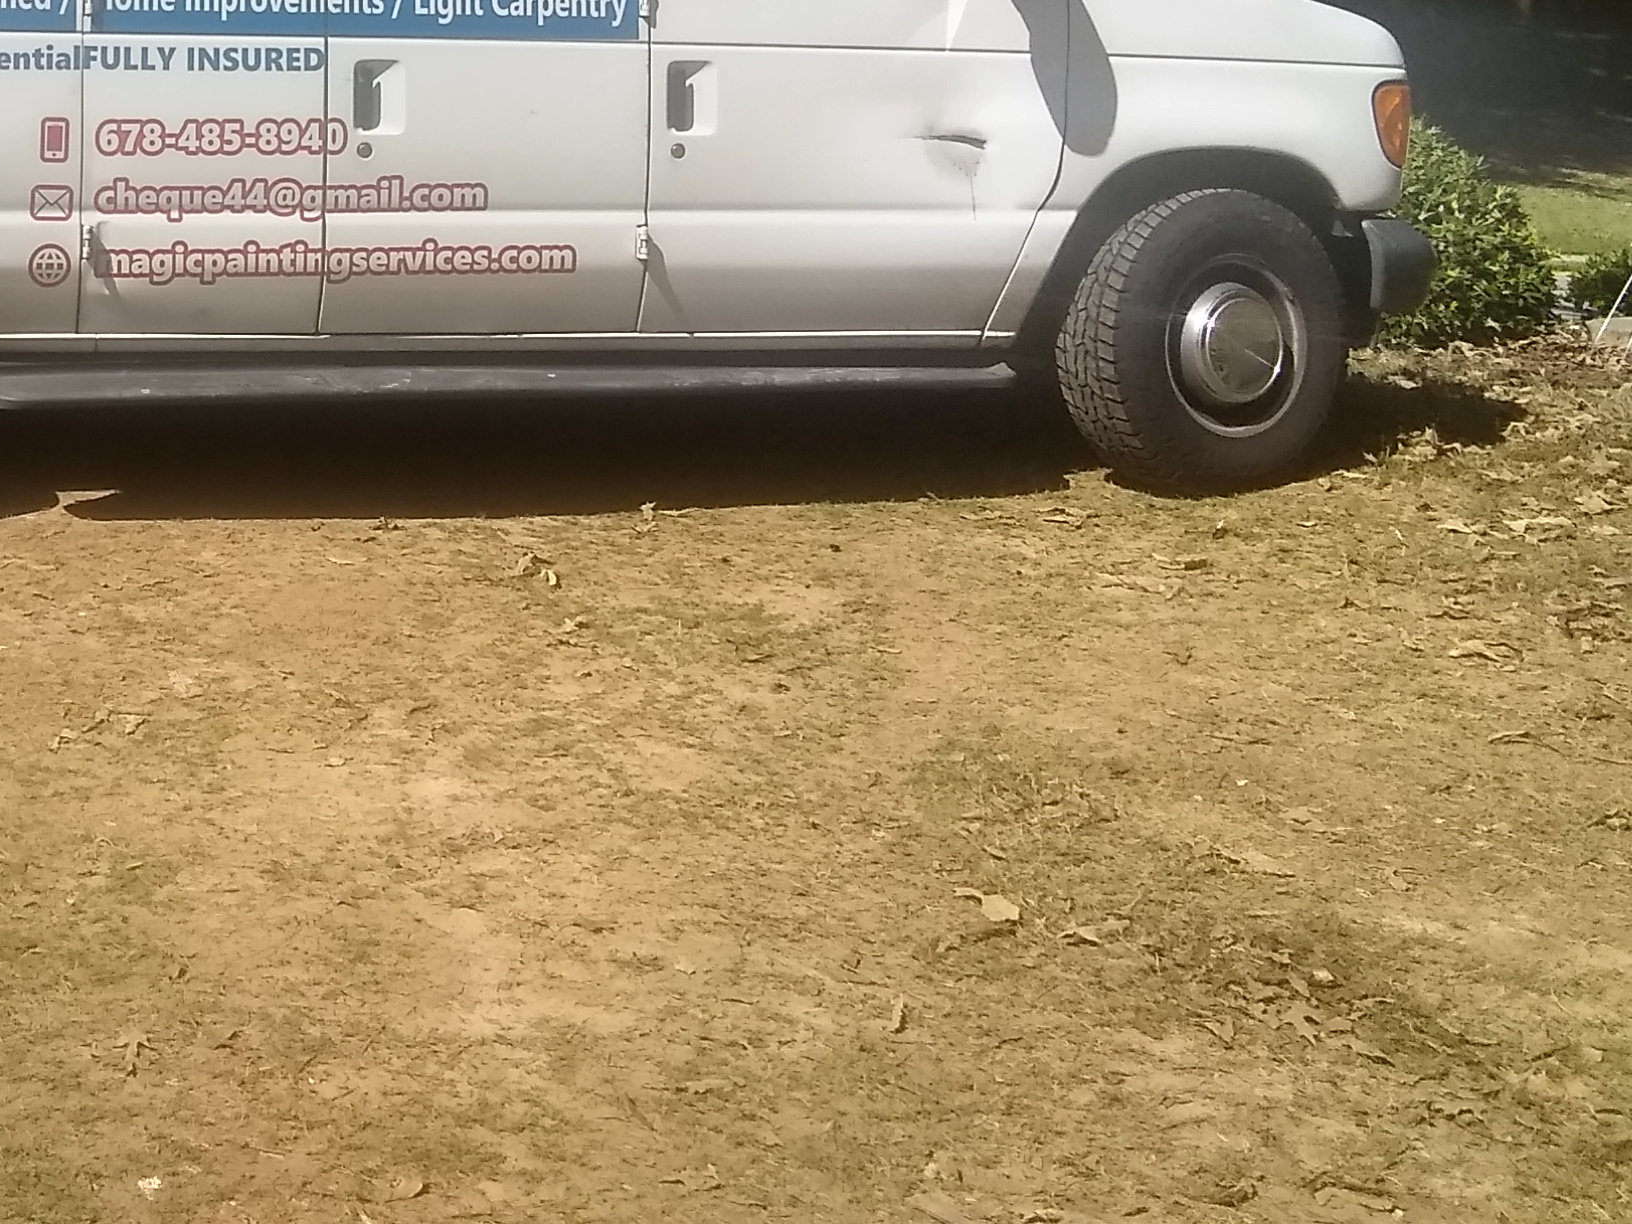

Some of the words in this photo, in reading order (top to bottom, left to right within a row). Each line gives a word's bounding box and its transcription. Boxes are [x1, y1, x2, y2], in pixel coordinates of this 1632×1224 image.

[83, 46, 177, 71] FULLY
[186, 47, 325, 73] INSURED
[96, 119, 347, 155] 678-485-8940
[96, 177, 487, 222] cheque44@gmail.com
[105, 241, 575, 285] magicpaintingservices.com
